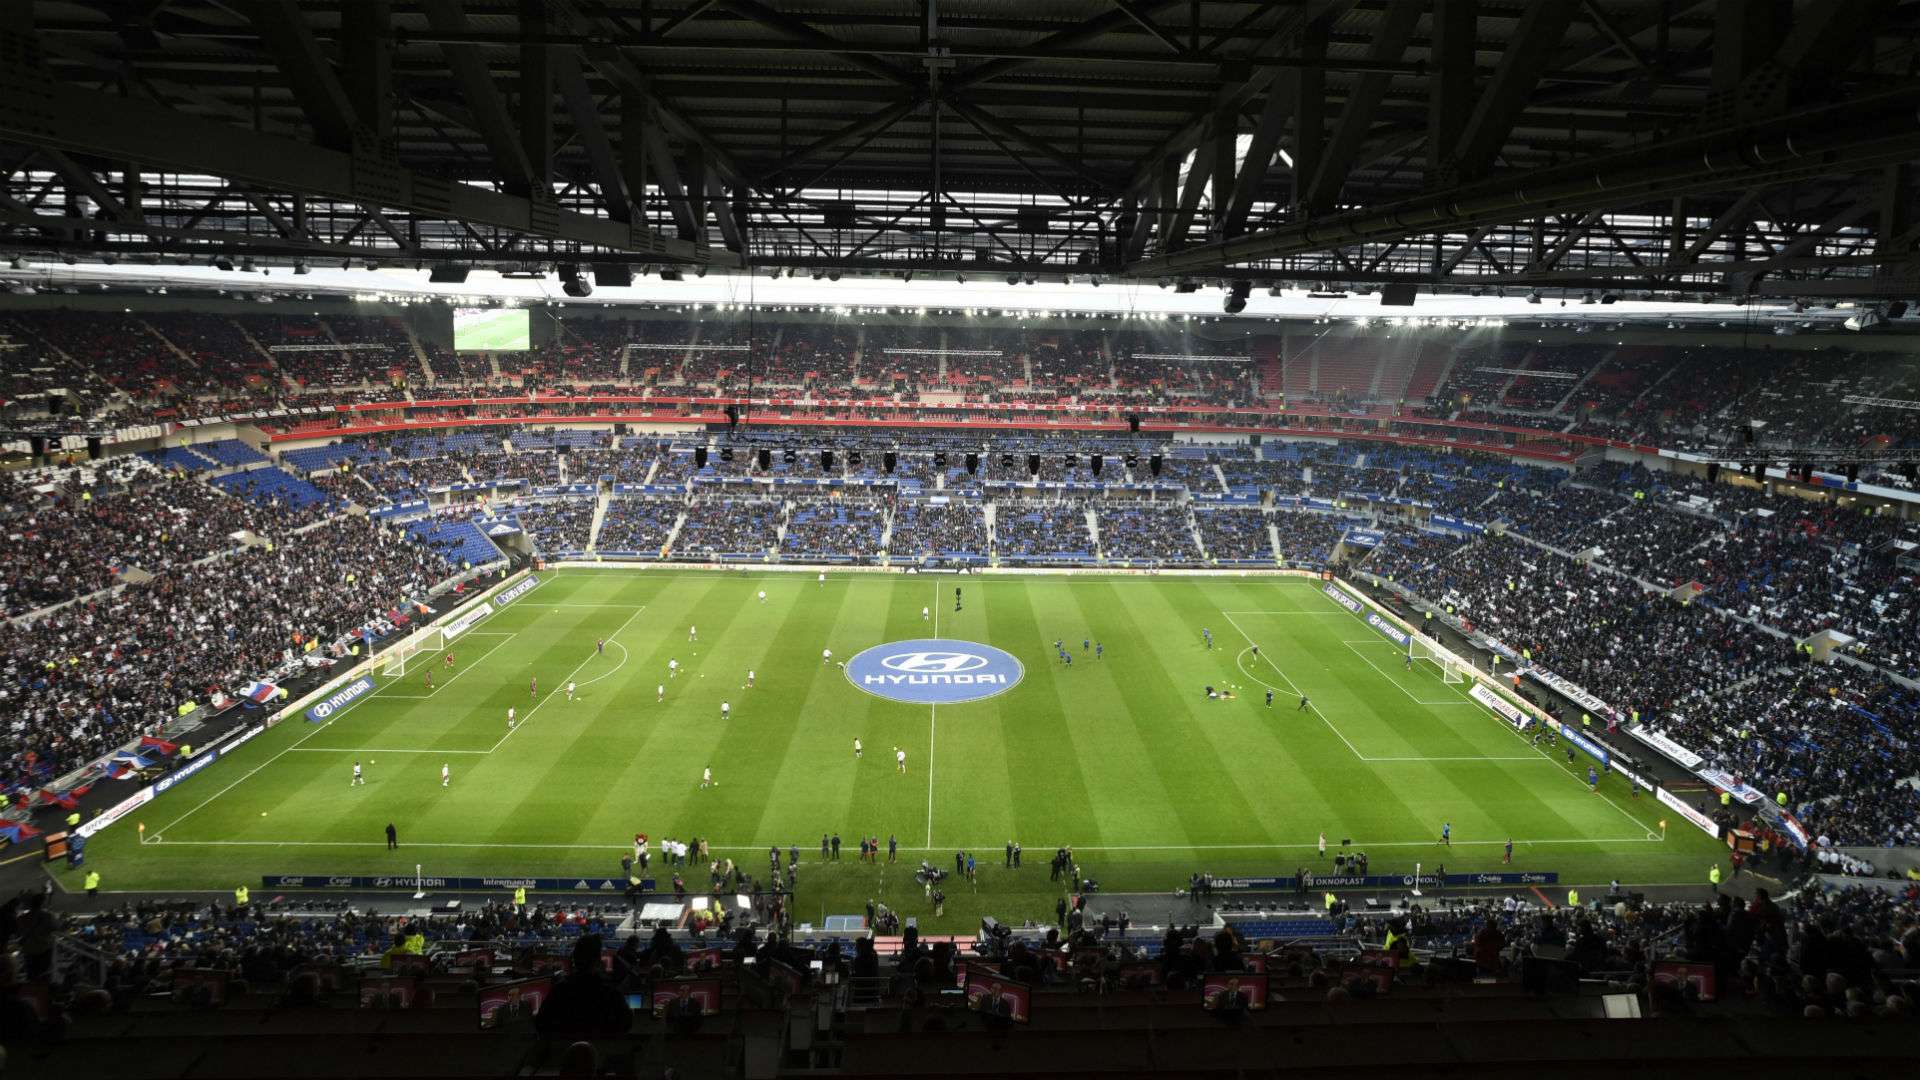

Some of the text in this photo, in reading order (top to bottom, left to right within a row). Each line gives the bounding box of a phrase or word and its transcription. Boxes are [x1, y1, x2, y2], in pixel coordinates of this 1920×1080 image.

[115, 424, 162, 443] NORD
[1380, 620, 1407, 643] HYUNDAI
[865, 674, 1006, 684] HYUNDAI
[329, 679, 370, 708] HYUNDAI
[173, 754, 214, 782] HYUNDAI
[395, 877, 446, 887] HYUNDAI
[1316, 877, 1365, 886] OKNOPLAST
